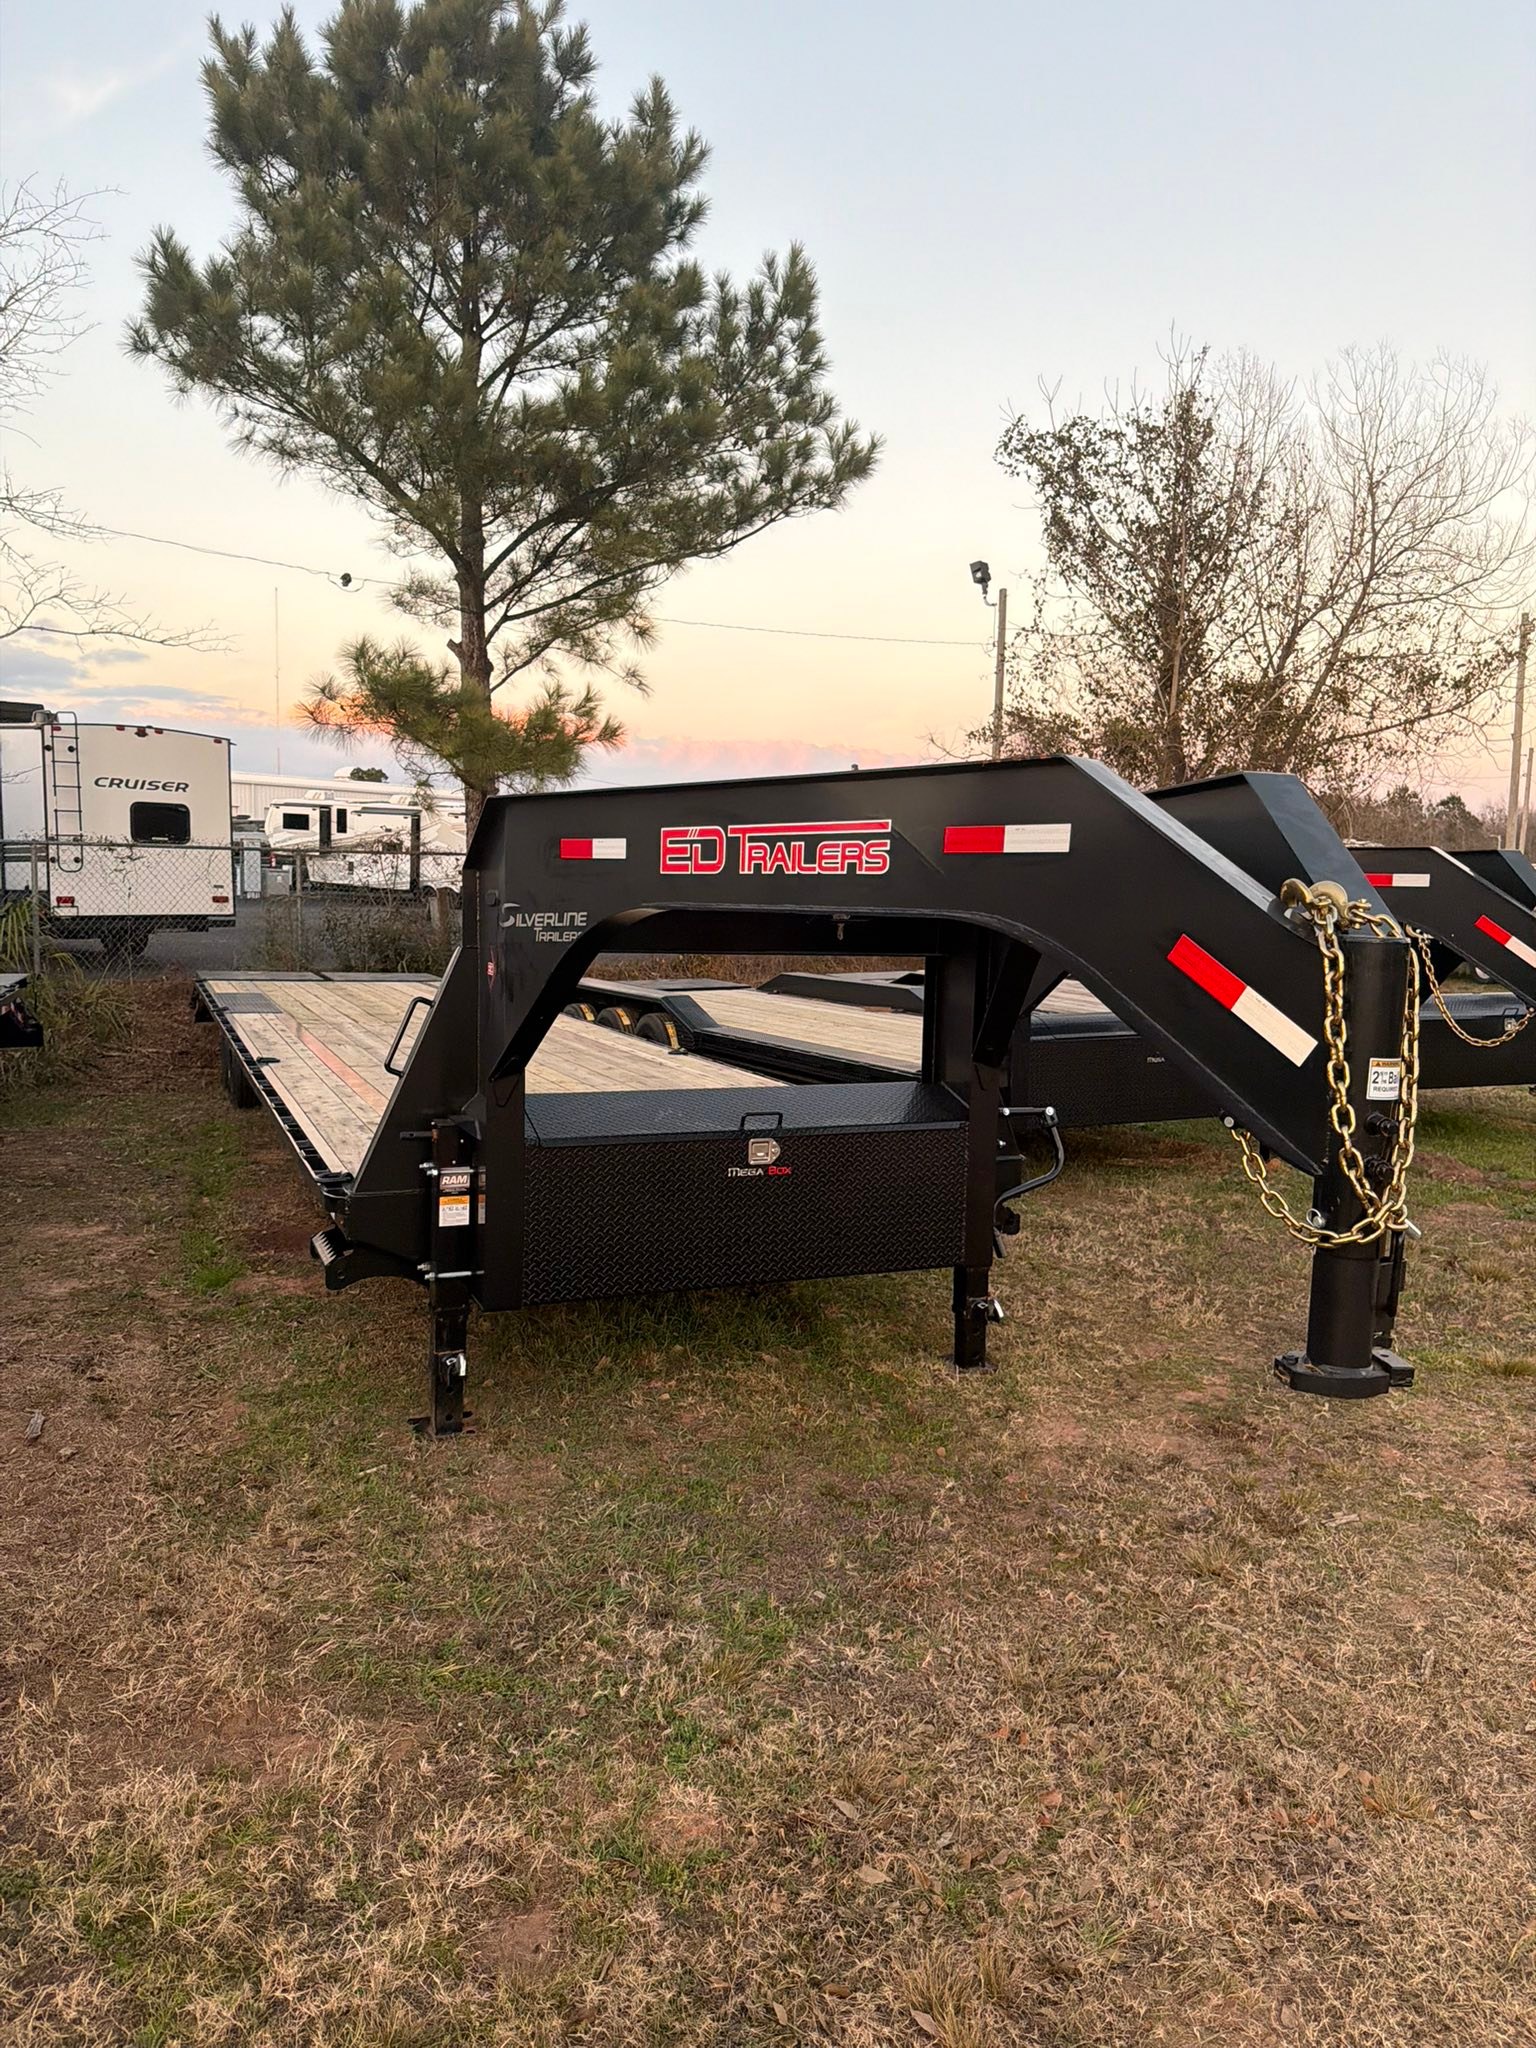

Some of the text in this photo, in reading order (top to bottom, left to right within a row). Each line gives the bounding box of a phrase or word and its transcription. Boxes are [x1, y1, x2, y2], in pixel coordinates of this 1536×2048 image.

[94, 777, 190, 792] CRUISER
[660, 819, 892, 874] ED TRAILERS
[500, 903, 588, 928] SILVERLINE
[727, 1166, 792, 1177] MEGA BOX
[441, 1175, 468, 1185] RAM
